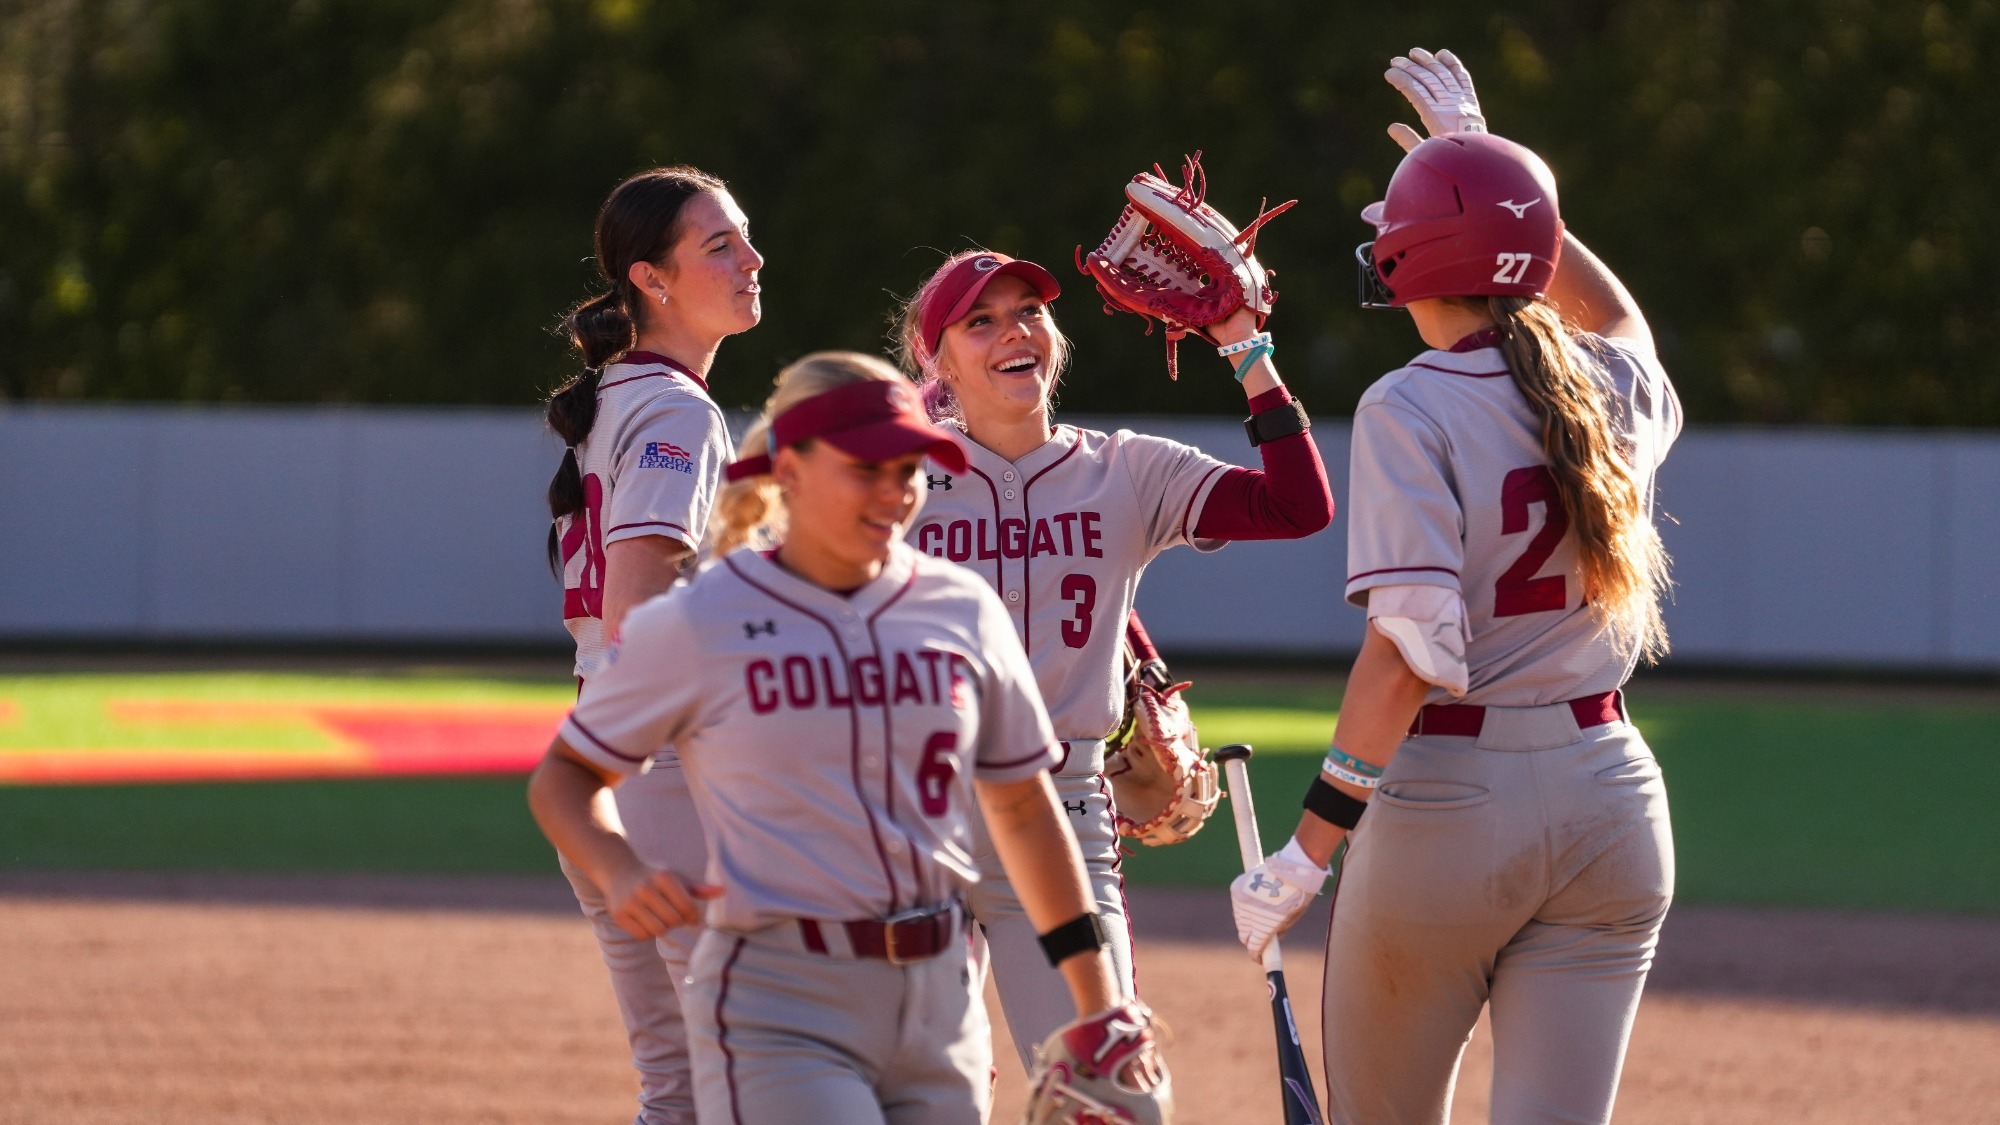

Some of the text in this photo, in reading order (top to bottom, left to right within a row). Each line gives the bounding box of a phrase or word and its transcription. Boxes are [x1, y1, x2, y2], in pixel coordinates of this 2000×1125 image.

[1492, 252, 1532, 284] 27
[638, 460, 692, 474] LEAGUE
[640, 455, 694, 469] PATRIOT
[918, 511, 1103, 562] COLGATE
[1493, 465, 1588, 618] 2
[1060, 573, 1097, 649] 3
[745, 650, 967, 716] COLGATE
[916, 730, 959, 819] 6
